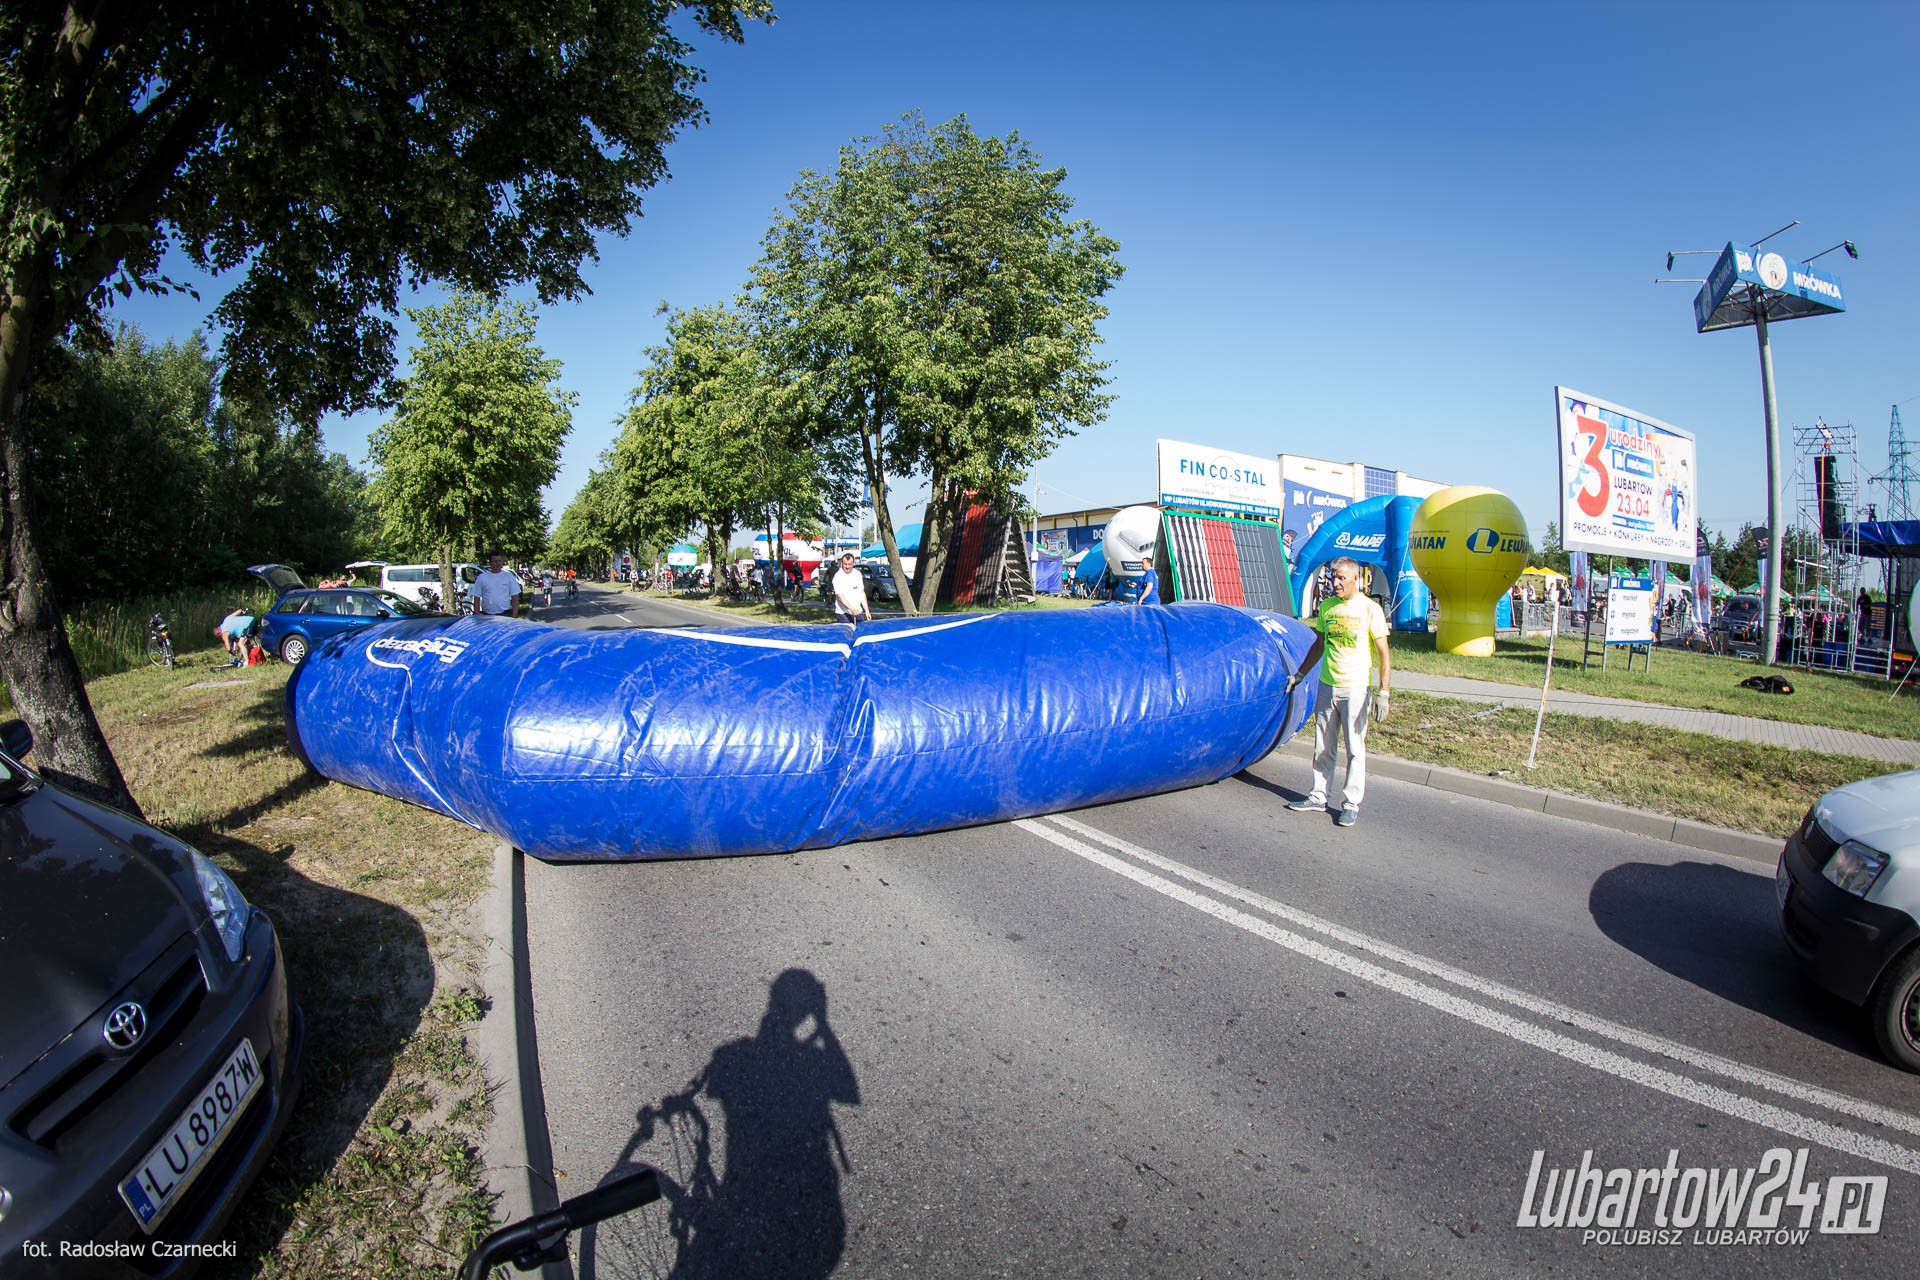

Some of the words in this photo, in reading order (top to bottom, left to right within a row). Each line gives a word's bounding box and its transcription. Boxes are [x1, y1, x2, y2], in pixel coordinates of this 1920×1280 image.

[1793, 271, 1842, 300] MRÓWKA
[1576, 414, 1609, 518] 3
[1616, 492, 1650, 517] 23.04
[1573, 521, 1607, 536] PROMOCJE
[1350, 535, 1386, 548] MAPEI
[144, 1133, 190, 1200] LU
[189, 1047, 255, 1147] 8987W
[138, 1202, 152, 1218] PL
